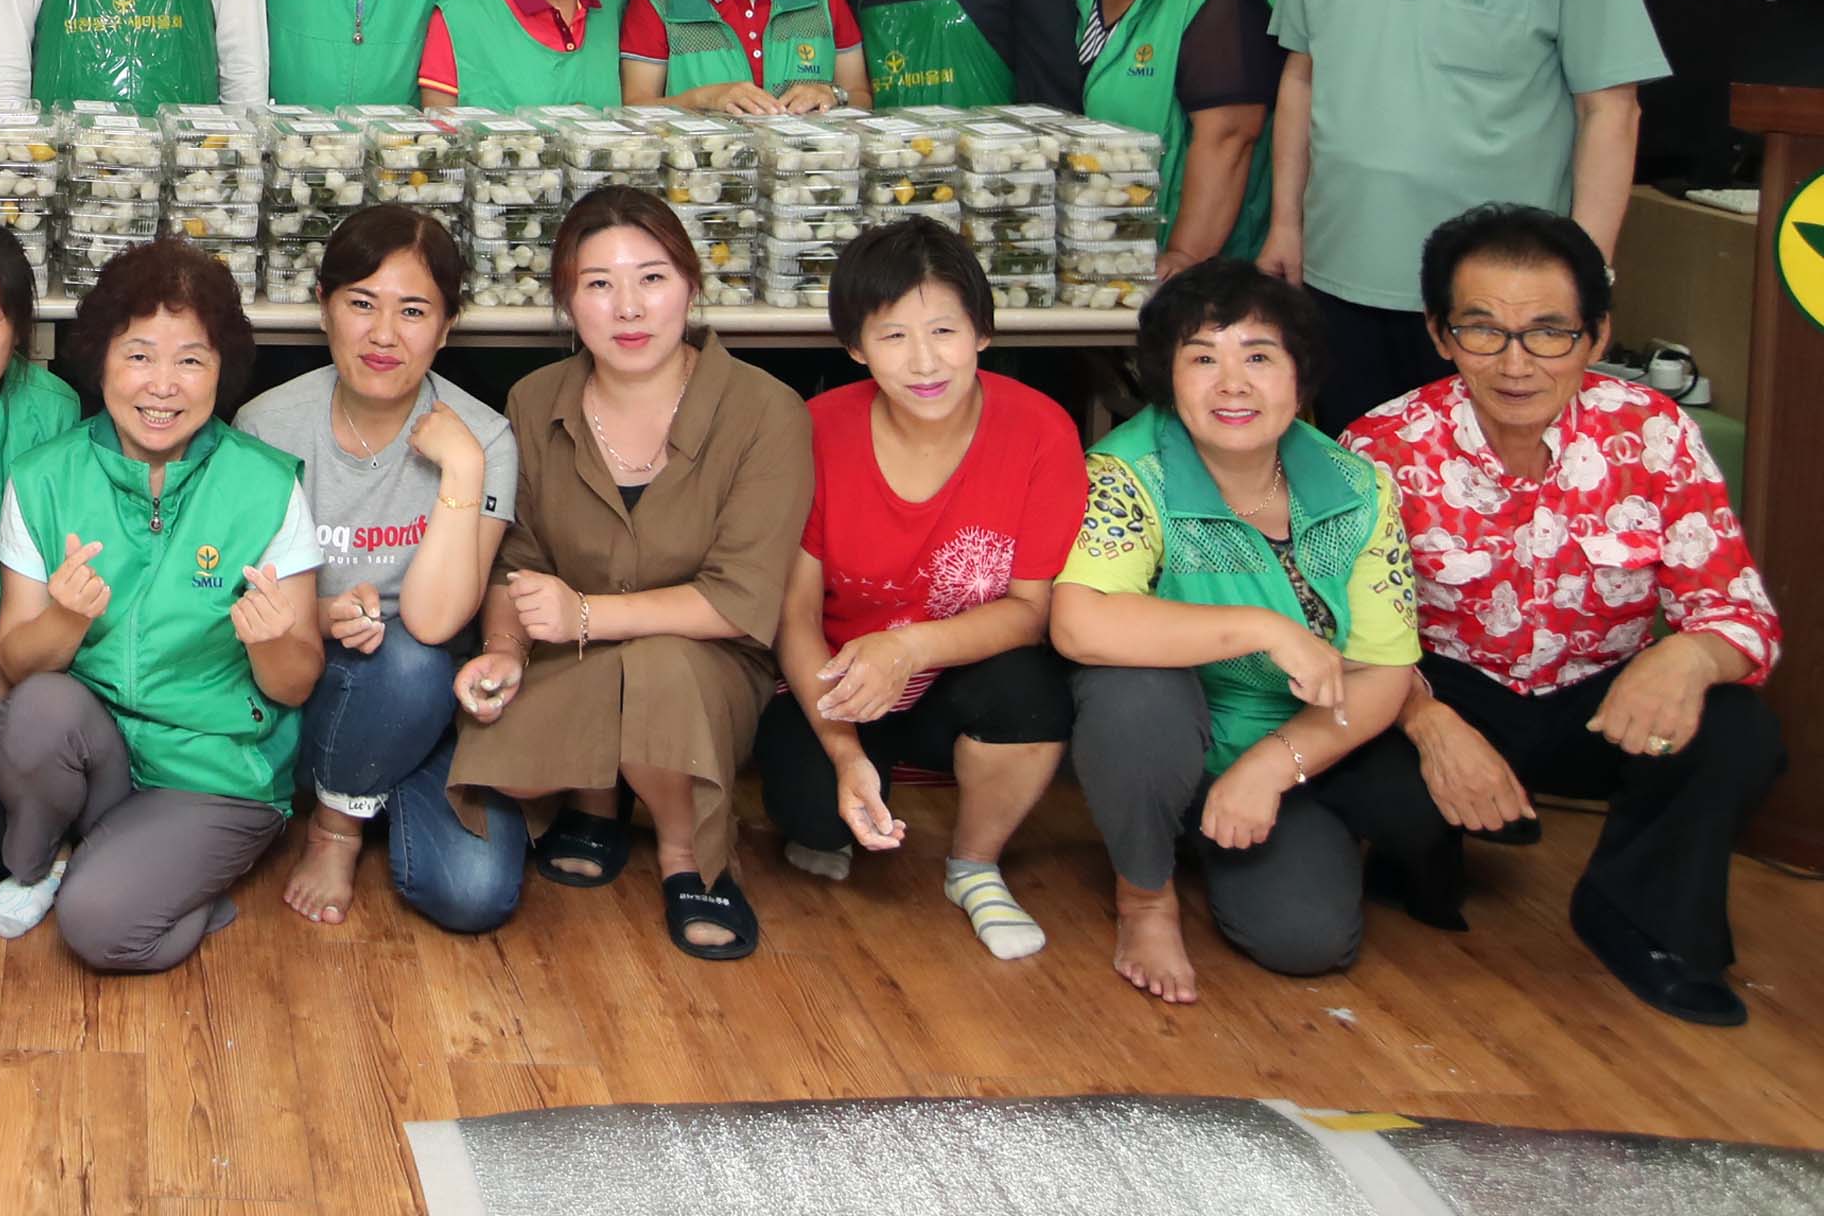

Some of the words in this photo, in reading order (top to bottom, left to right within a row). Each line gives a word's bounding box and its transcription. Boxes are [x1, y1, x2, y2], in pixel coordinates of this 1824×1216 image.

[796, 64, 821, 74] SMU
[1127, 67, 1155, 77] SMU
[316, 525, 351, 552] oq
[191, 576, 223, 588] SMU
